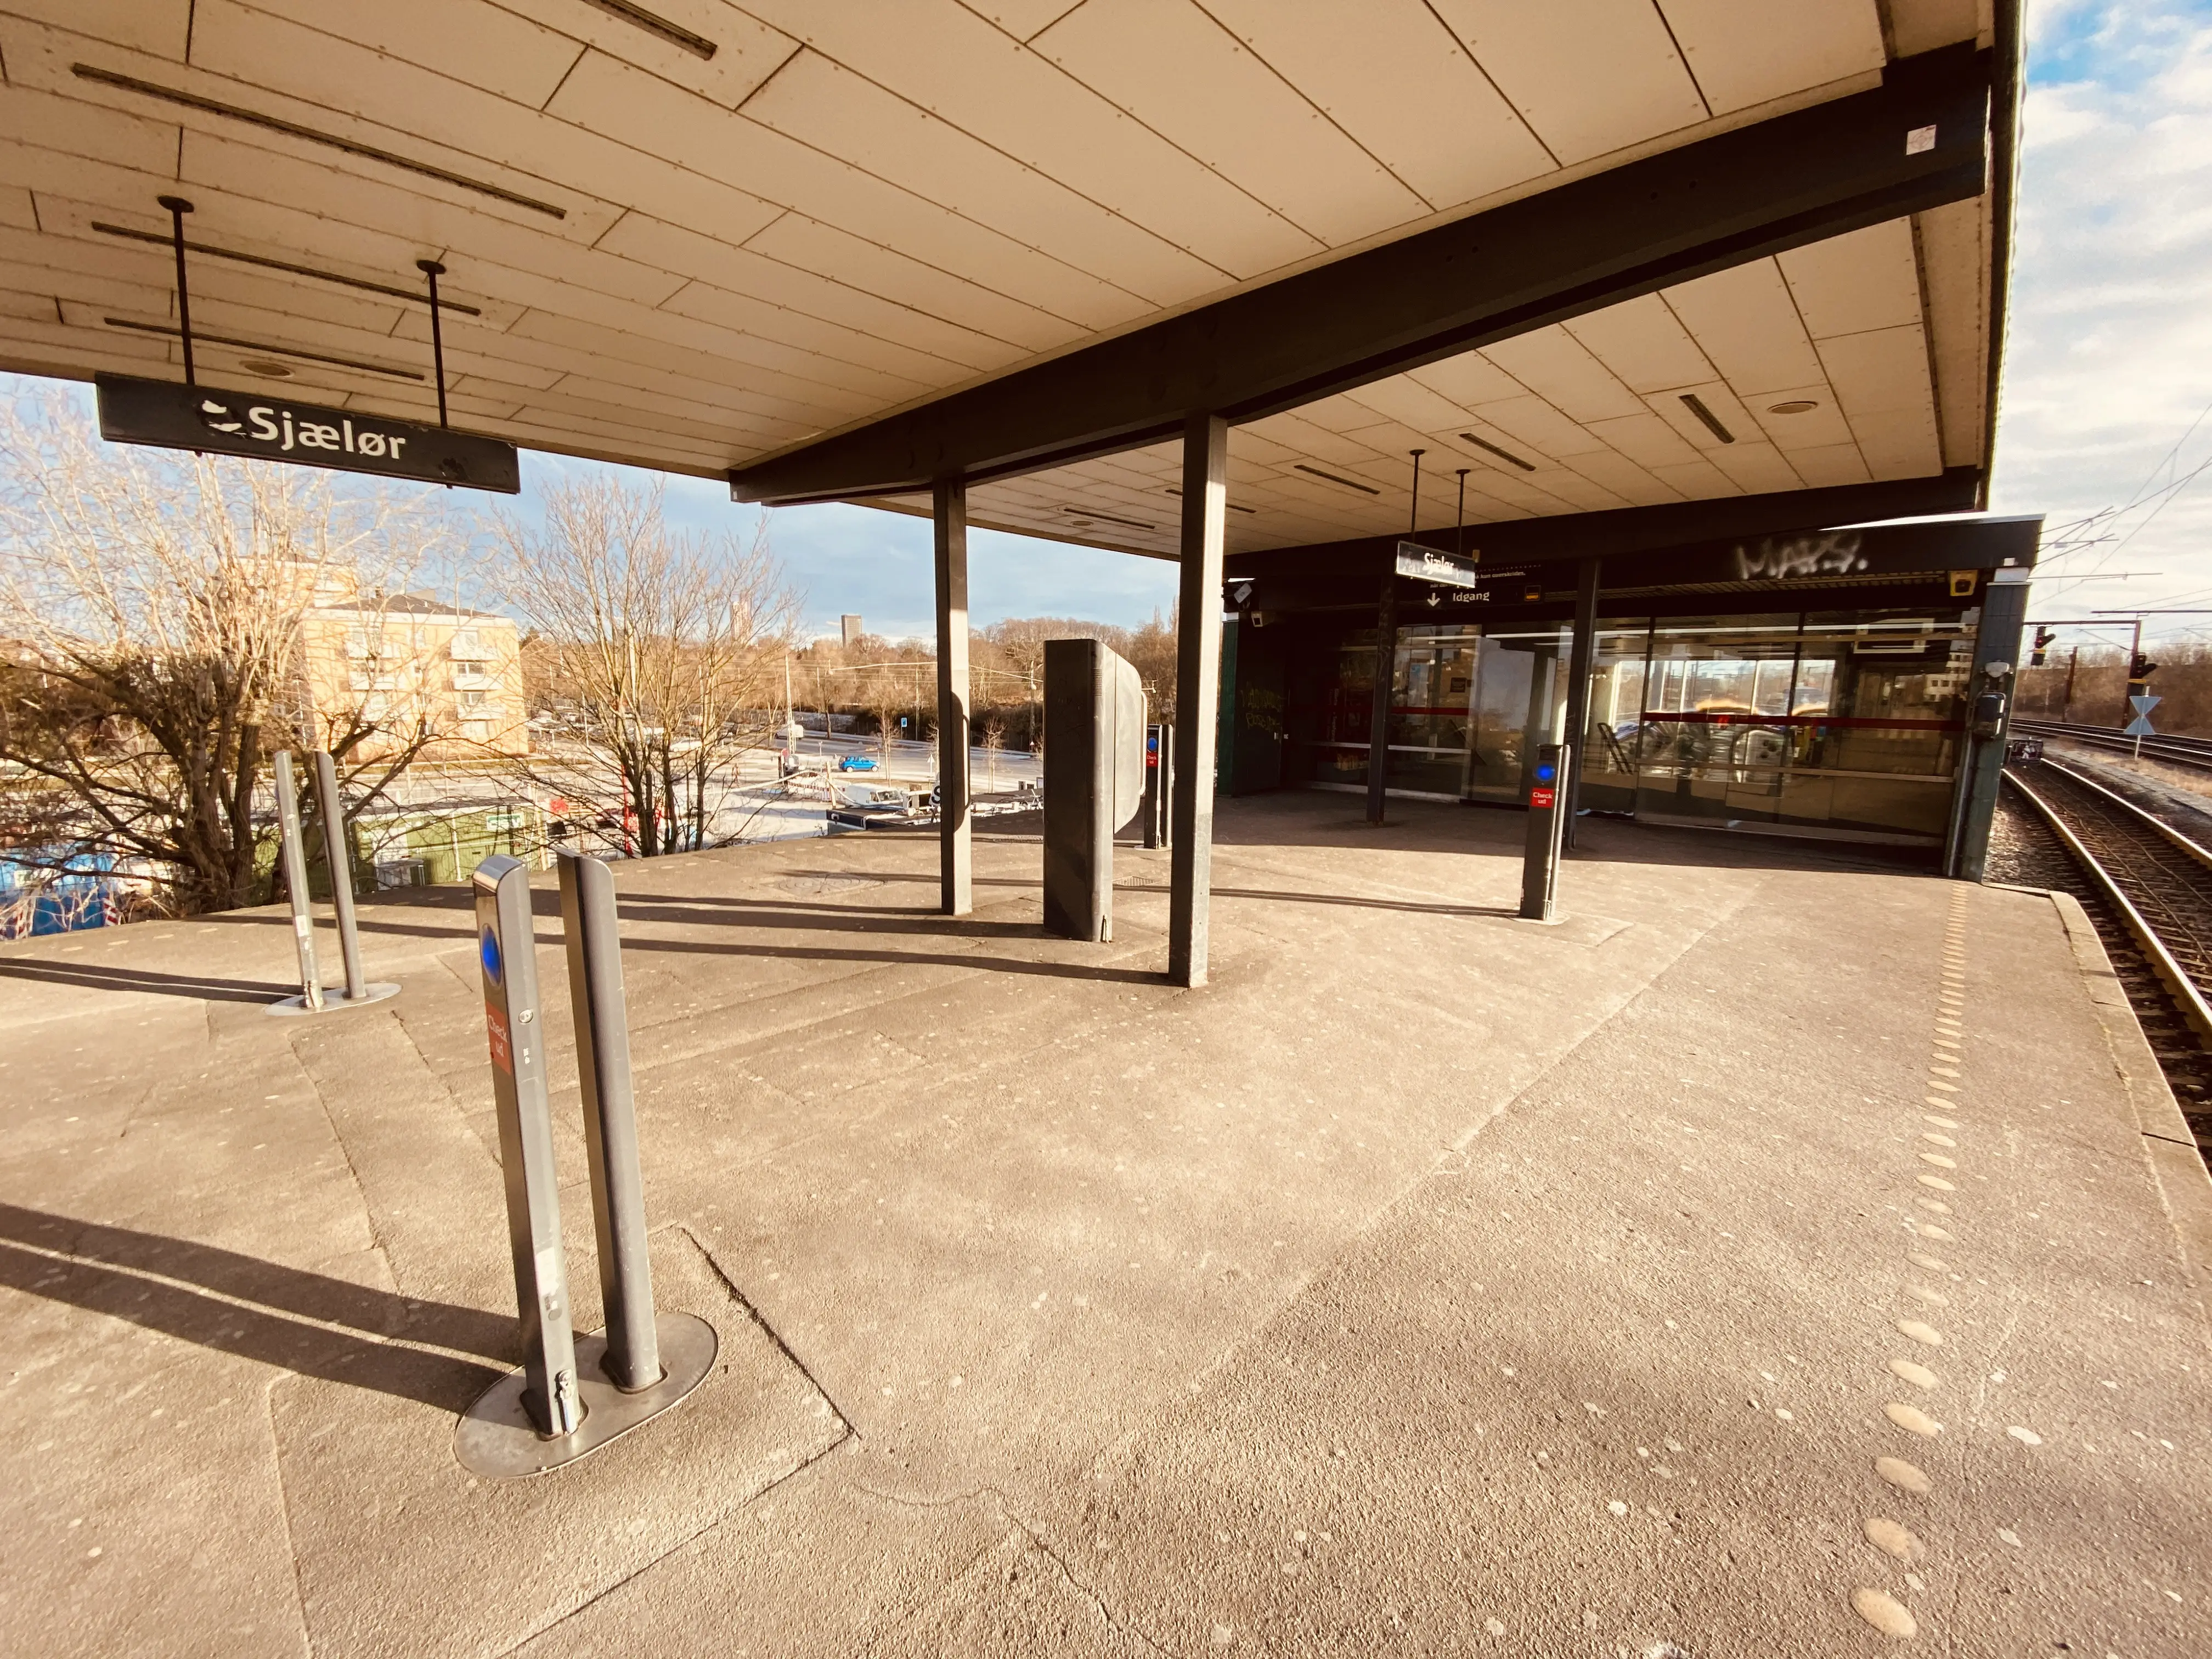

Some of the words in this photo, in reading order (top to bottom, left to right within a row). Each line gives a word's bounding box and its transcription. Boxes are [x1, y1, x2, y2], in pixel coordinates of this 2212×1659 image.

[249, 407, 406, 459] Sjælør
[1453, 592, 1489, 602] Idgang
[488, 1014, 507, 1043] Check
[495, 1041, 504, 1057] ud
